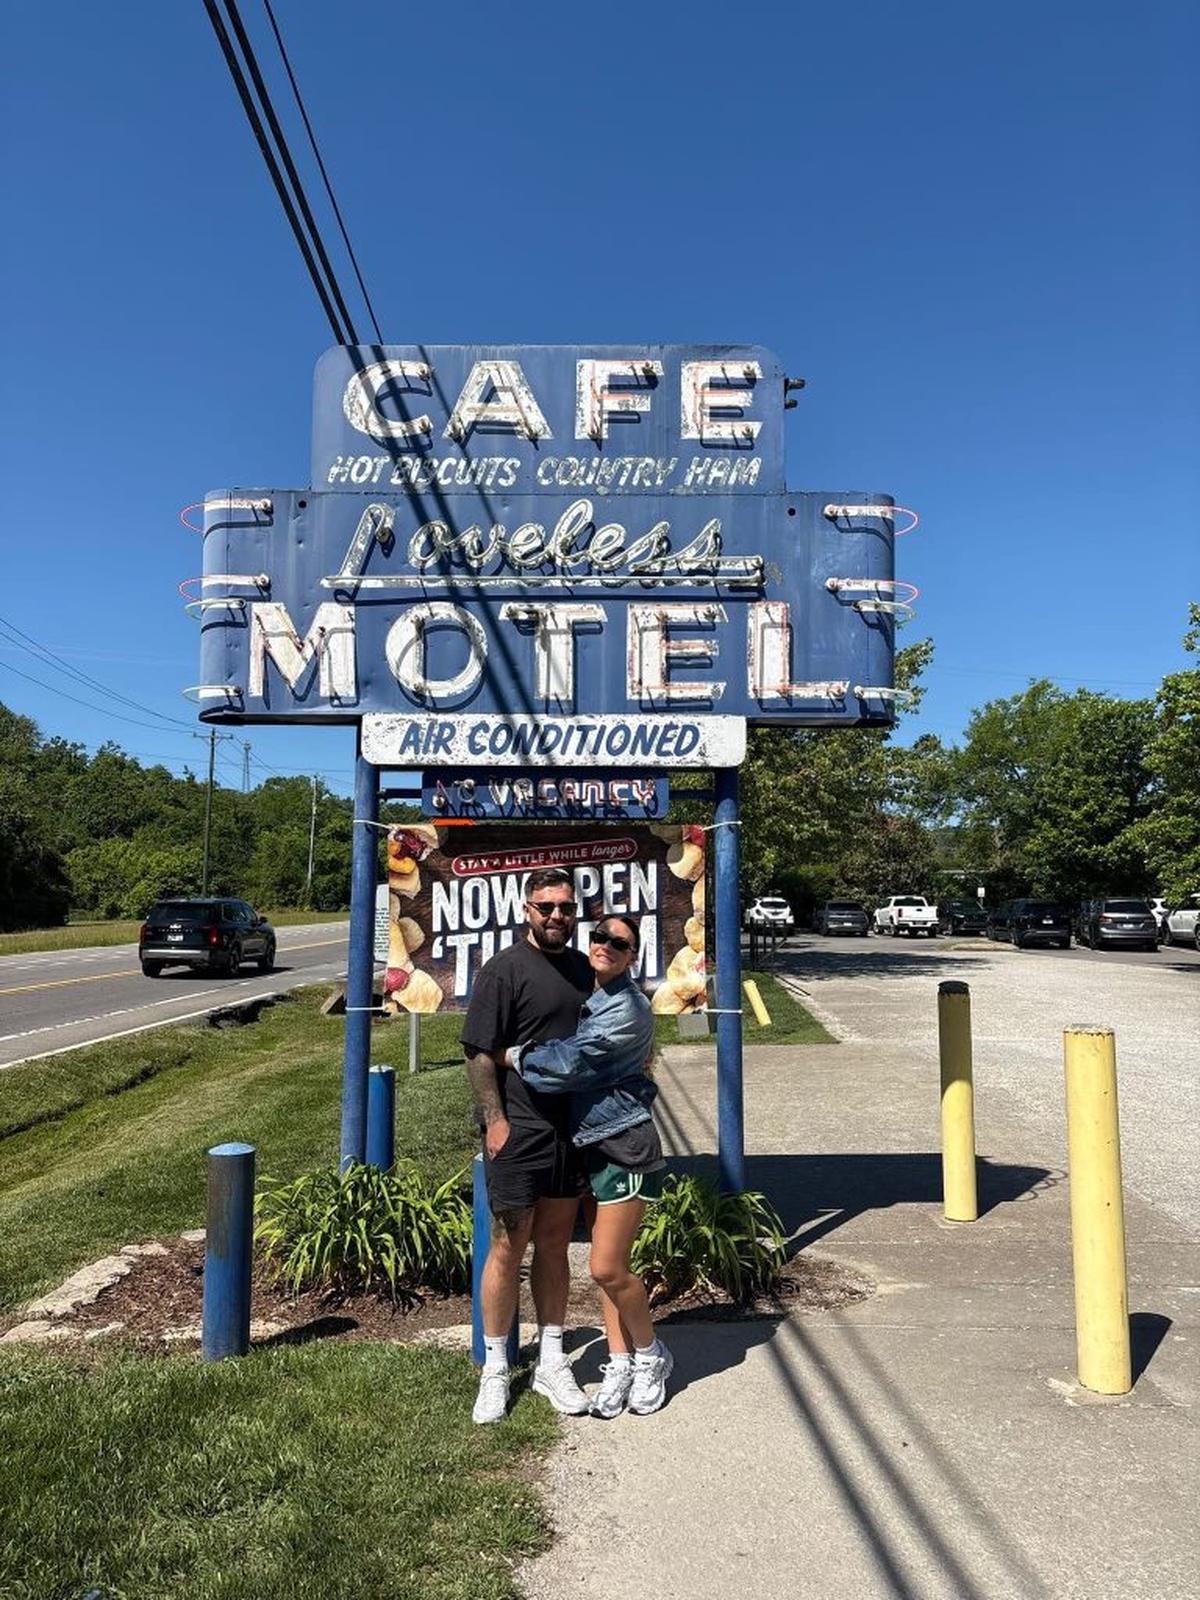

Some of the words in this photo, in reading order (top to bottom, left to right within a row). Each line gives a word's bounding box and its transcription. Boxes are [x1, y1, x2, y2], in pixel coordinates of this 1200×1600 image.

[342, 359, 765, 440] CAFE
[327, 455, 390, 484] HOT
[390, 456, 521, 487] BISCUITS
[536, 456, 679, 487] COUNTRY
[683, 456, 763, 487] HAM
[320, 498, 768, 588] Loveless
[248, 601, 851, 700] MOTEL
[399, 722, 453, 756] AIR
[467, 722, 700, 756] CONDITIONED
[459, 857, 489, 870] STAY
[504, 852, 545, 866] LITTLE
[549, 847, 588, 862] WHILE
[591, 841, 632, 858] longer
[431, 872, 530, 932] NOW
[560, 859, 658, 918] PEN
